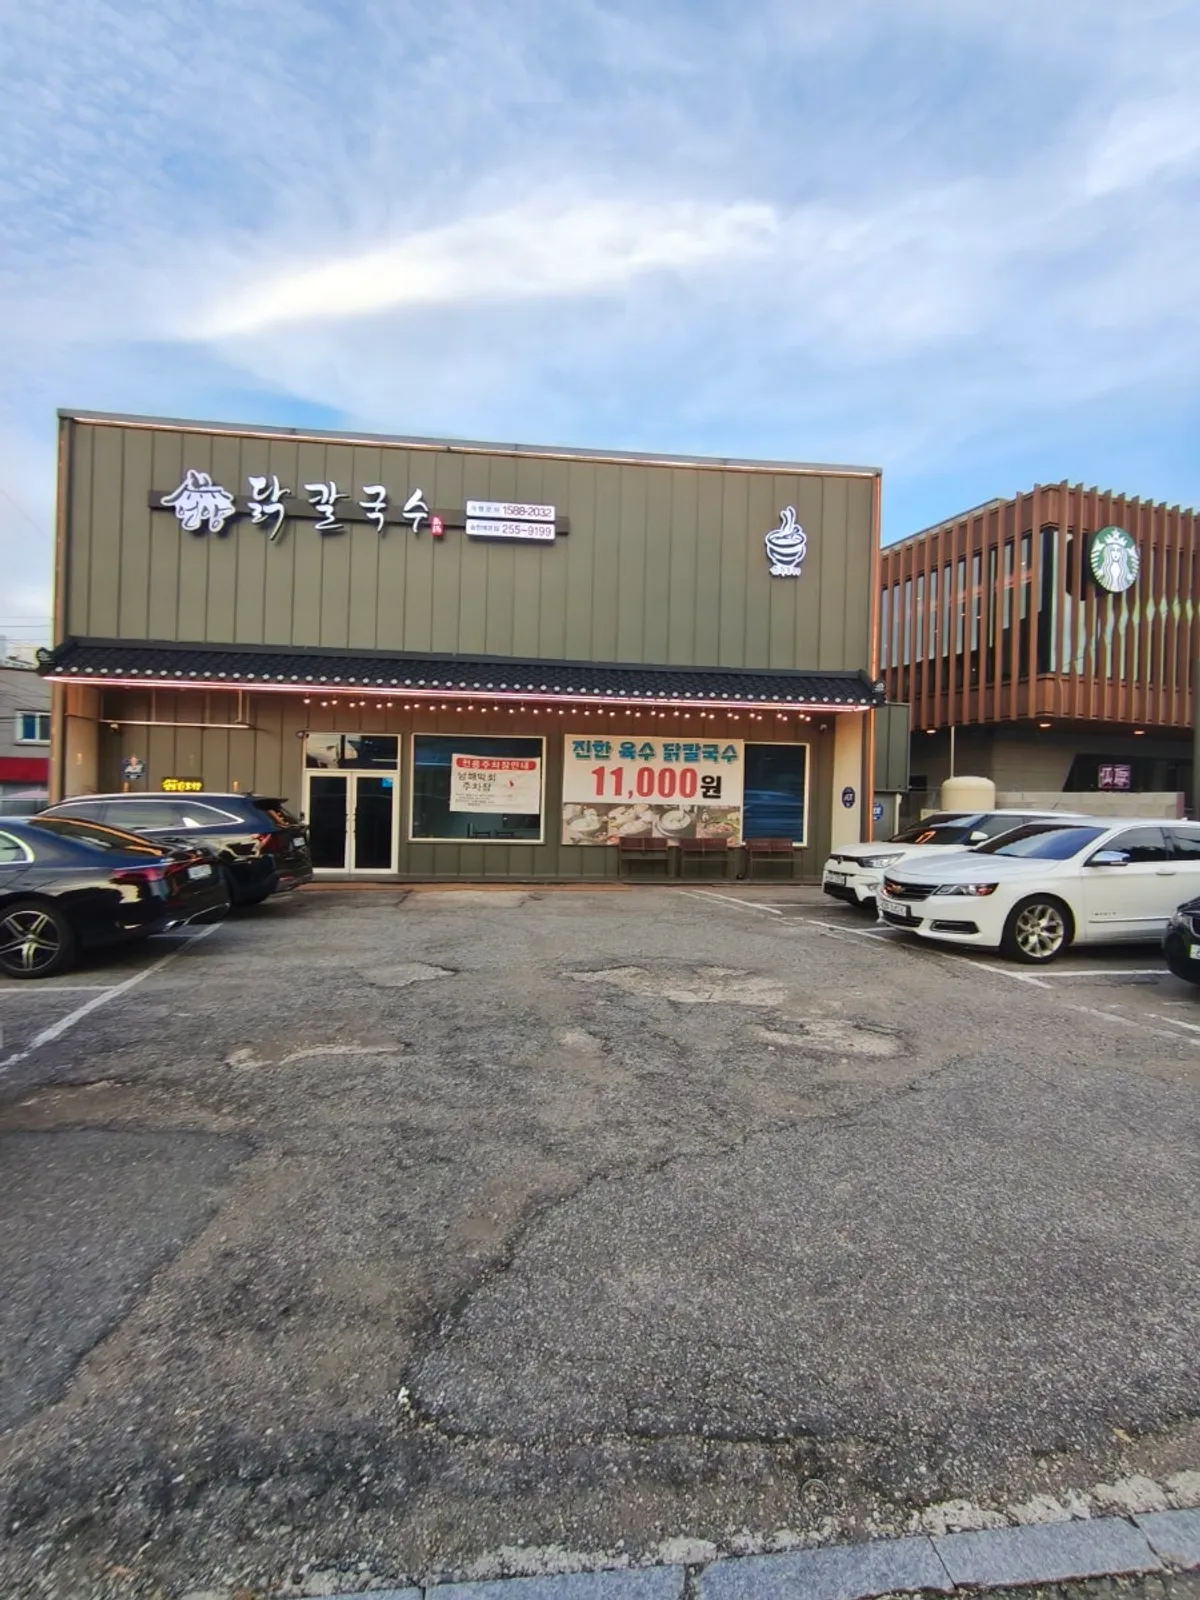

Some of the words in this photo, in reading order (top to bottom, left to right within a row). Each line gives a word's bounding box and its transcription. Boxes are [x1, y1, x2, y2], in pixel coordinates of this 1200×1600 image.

[503, 505, 552, 518] 1588-2032
[502, 524, 552, 537] 255-9199
[572, 740, 612, 761] 진한
[619, 741, 657, 762] 육수
[662, 742, 739, 764] 닭칼국수
